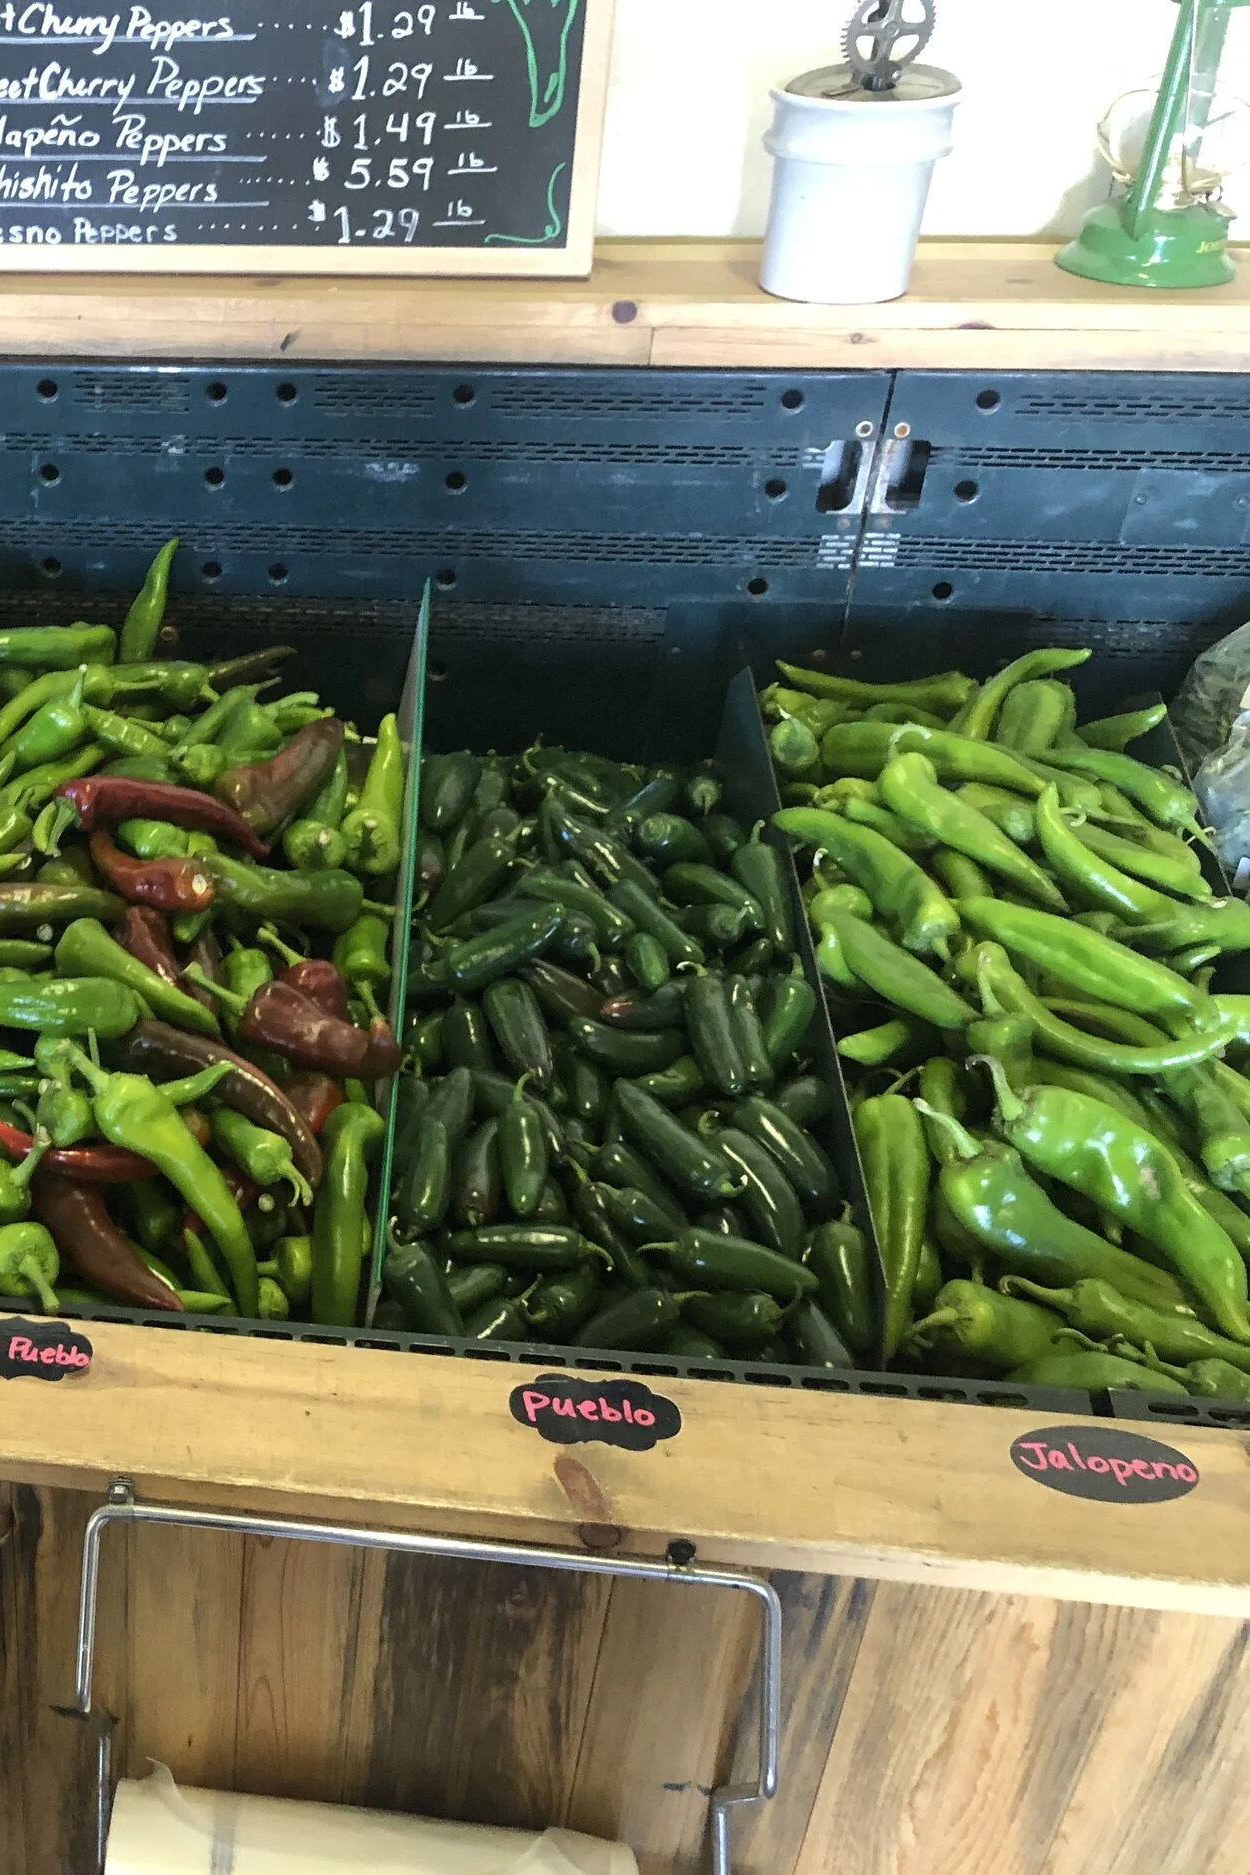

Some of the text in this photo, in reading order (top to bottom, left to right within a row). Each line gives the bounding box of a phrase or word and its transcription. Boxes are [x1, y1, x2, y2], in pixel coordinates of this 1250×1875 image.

[126, 6, 234, 50] Peppers
[147, 56, 266, 114] Peppers
[112, 114, 227, 167] Peppers
[106, 168, 218, 212] Peppers
[73, 216, 178, 243] Peppers
[8, 1336, 90, 1366] Pueblo
[522, 1391, 656, 1426] Pueblo
